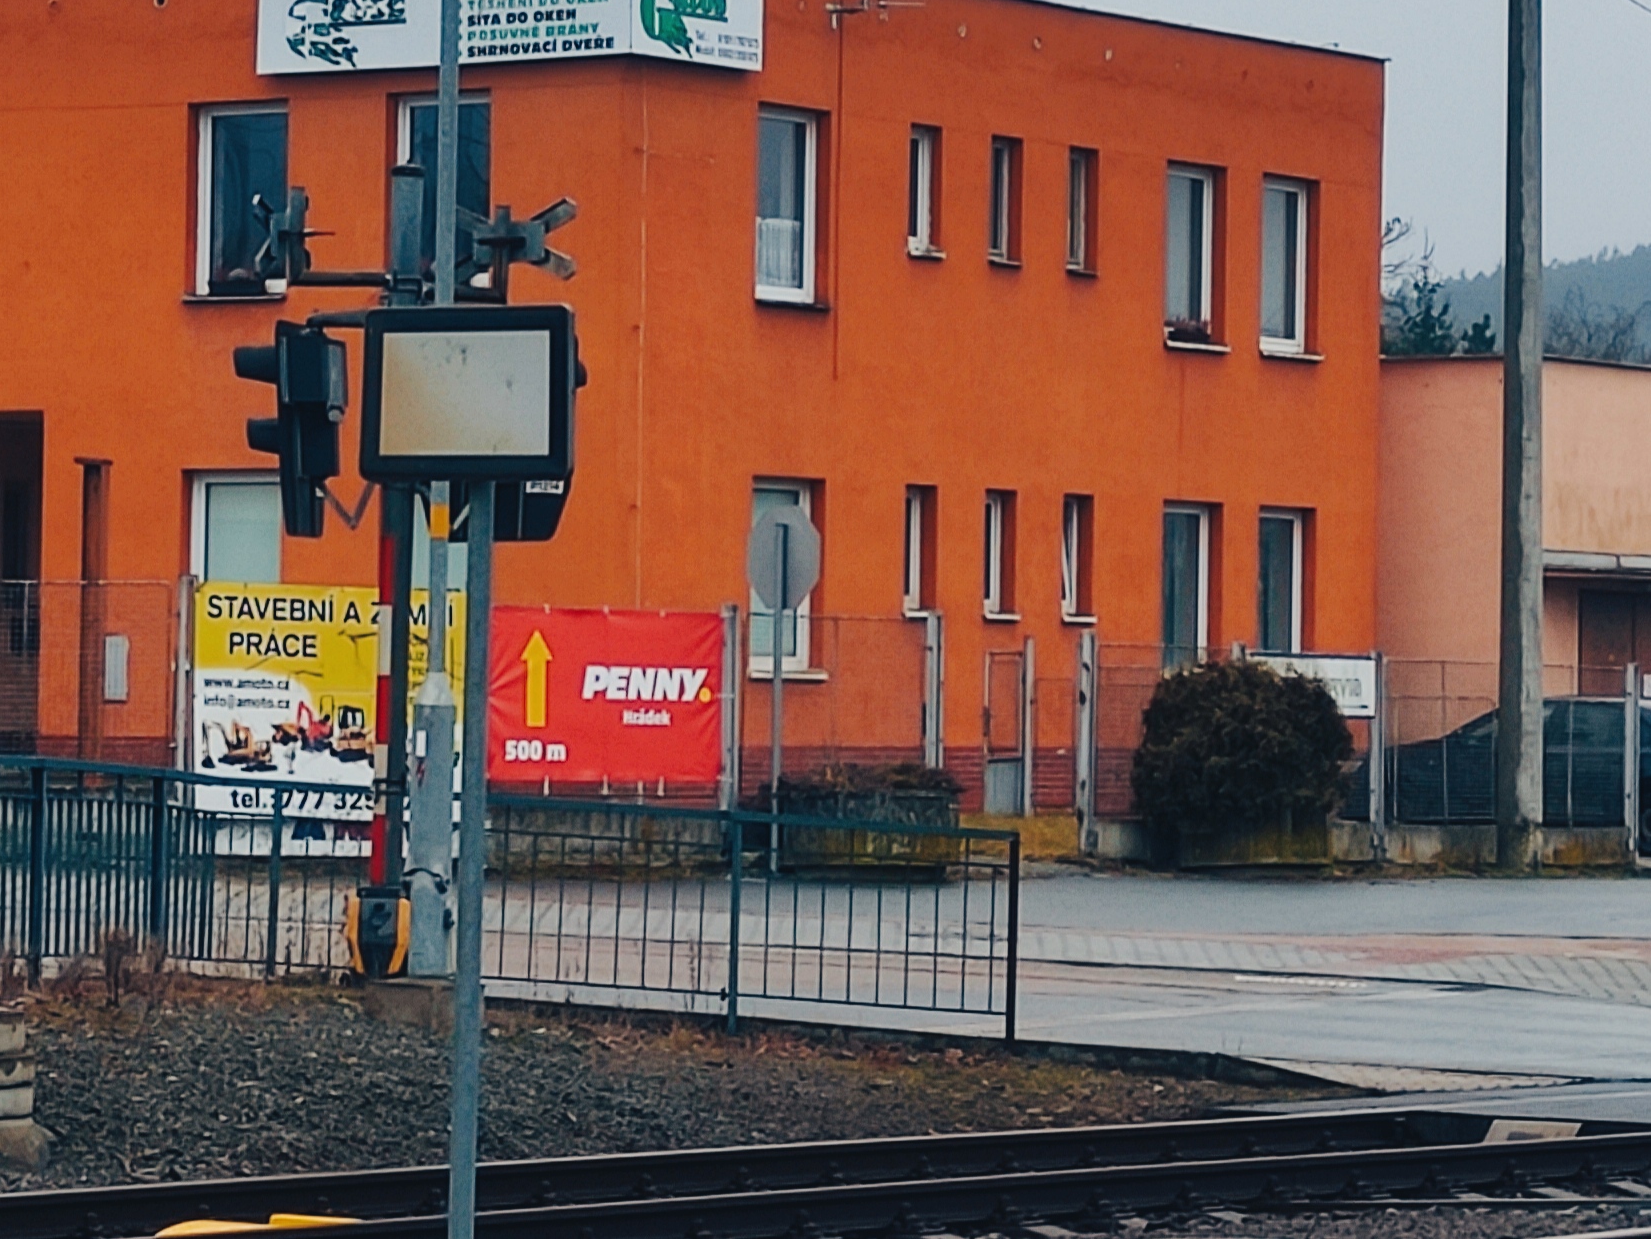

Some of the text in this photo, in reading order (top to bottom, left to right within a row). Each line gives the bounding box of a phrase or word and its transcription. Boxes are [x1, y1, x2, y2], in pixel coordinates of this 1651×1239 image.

[505, 11, 529, 25] DO
[533, 9, 577, 24] OKEN
[467, 35, 615, 58] SHRNOVACÍ DVEŘE
[207, 594, 334, 623] STAVEBNÍ
[343, 601, 361, 624] A
[229, 628, 318, 658] PRÁCE
[504, 739, 567, 762] 500 m
